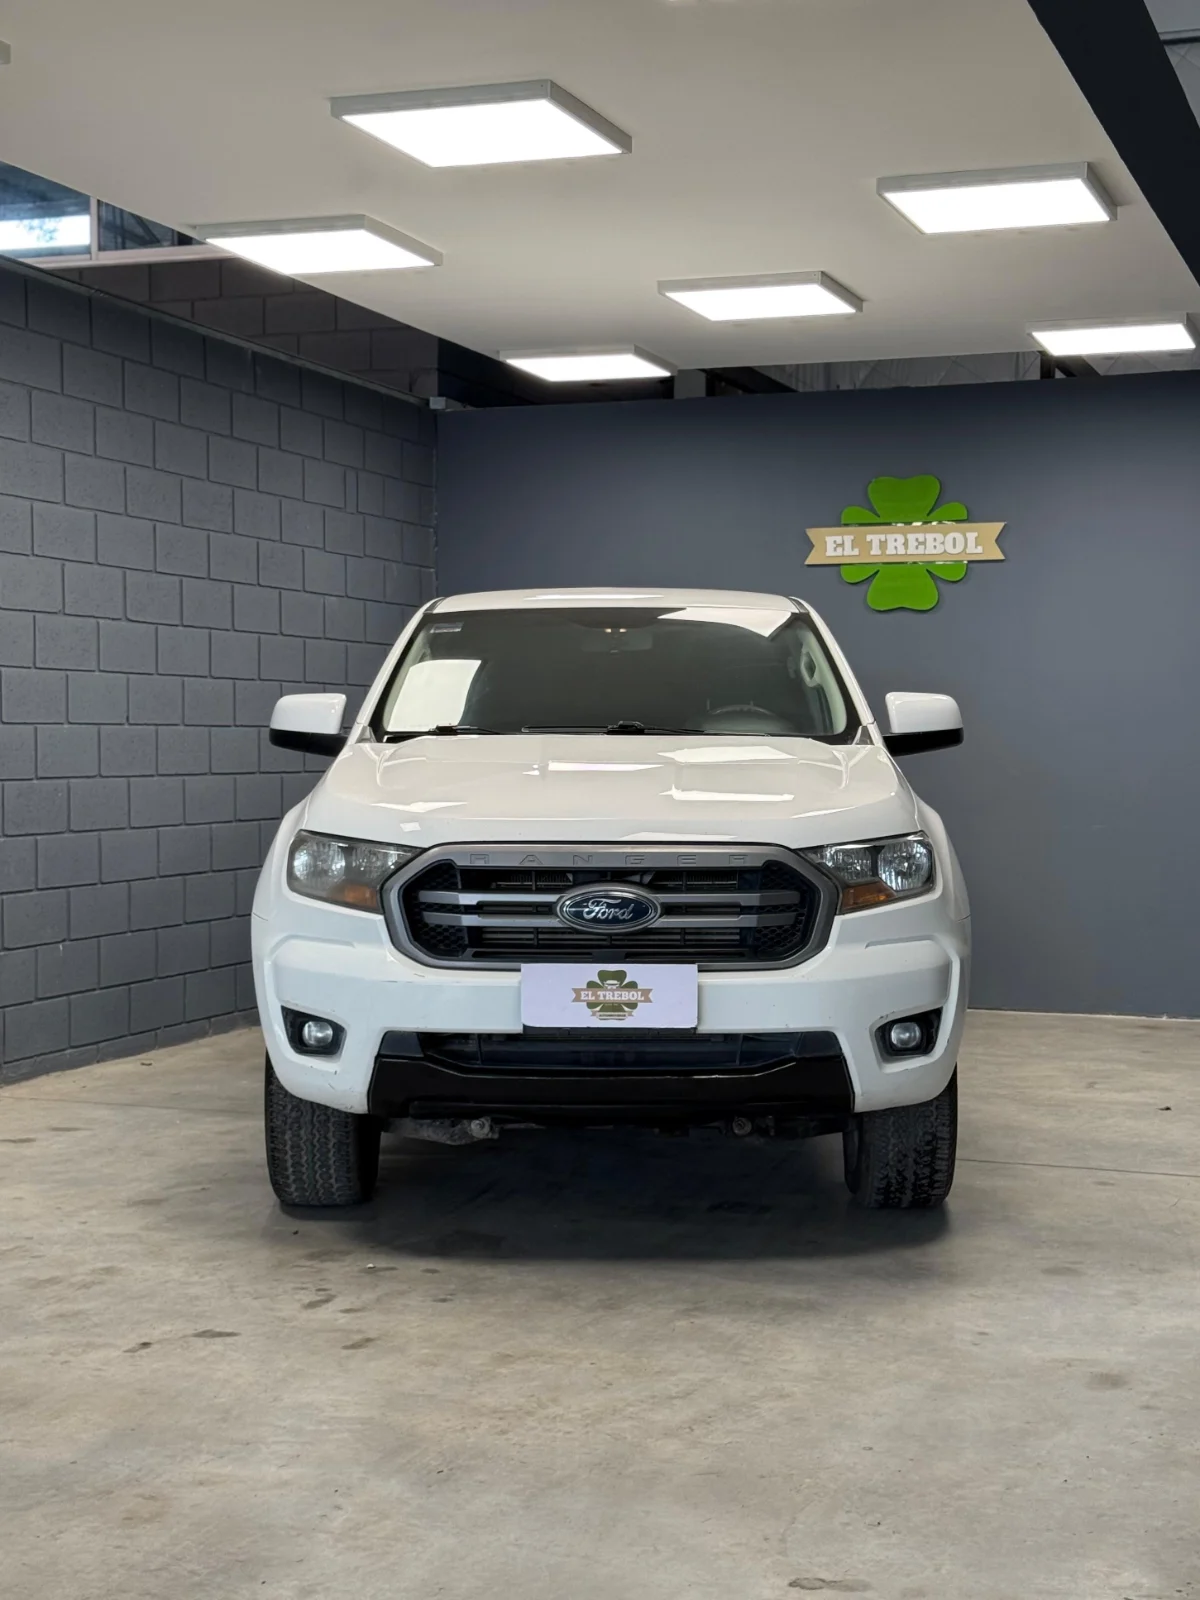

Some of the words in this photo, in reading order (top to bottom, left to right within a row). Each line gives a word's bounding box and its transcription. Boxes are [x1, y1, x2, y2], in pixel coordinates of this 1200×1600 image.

[825, 535, 859, 557] EL
[866, 532, 983, 556] TREBOL
[469, 853, 749, 866] RANGER
[582, 898, 635, 920] Ford
[580, 990, 596, 1001] EL
[597, 990, 645, 1001] TREBOL
